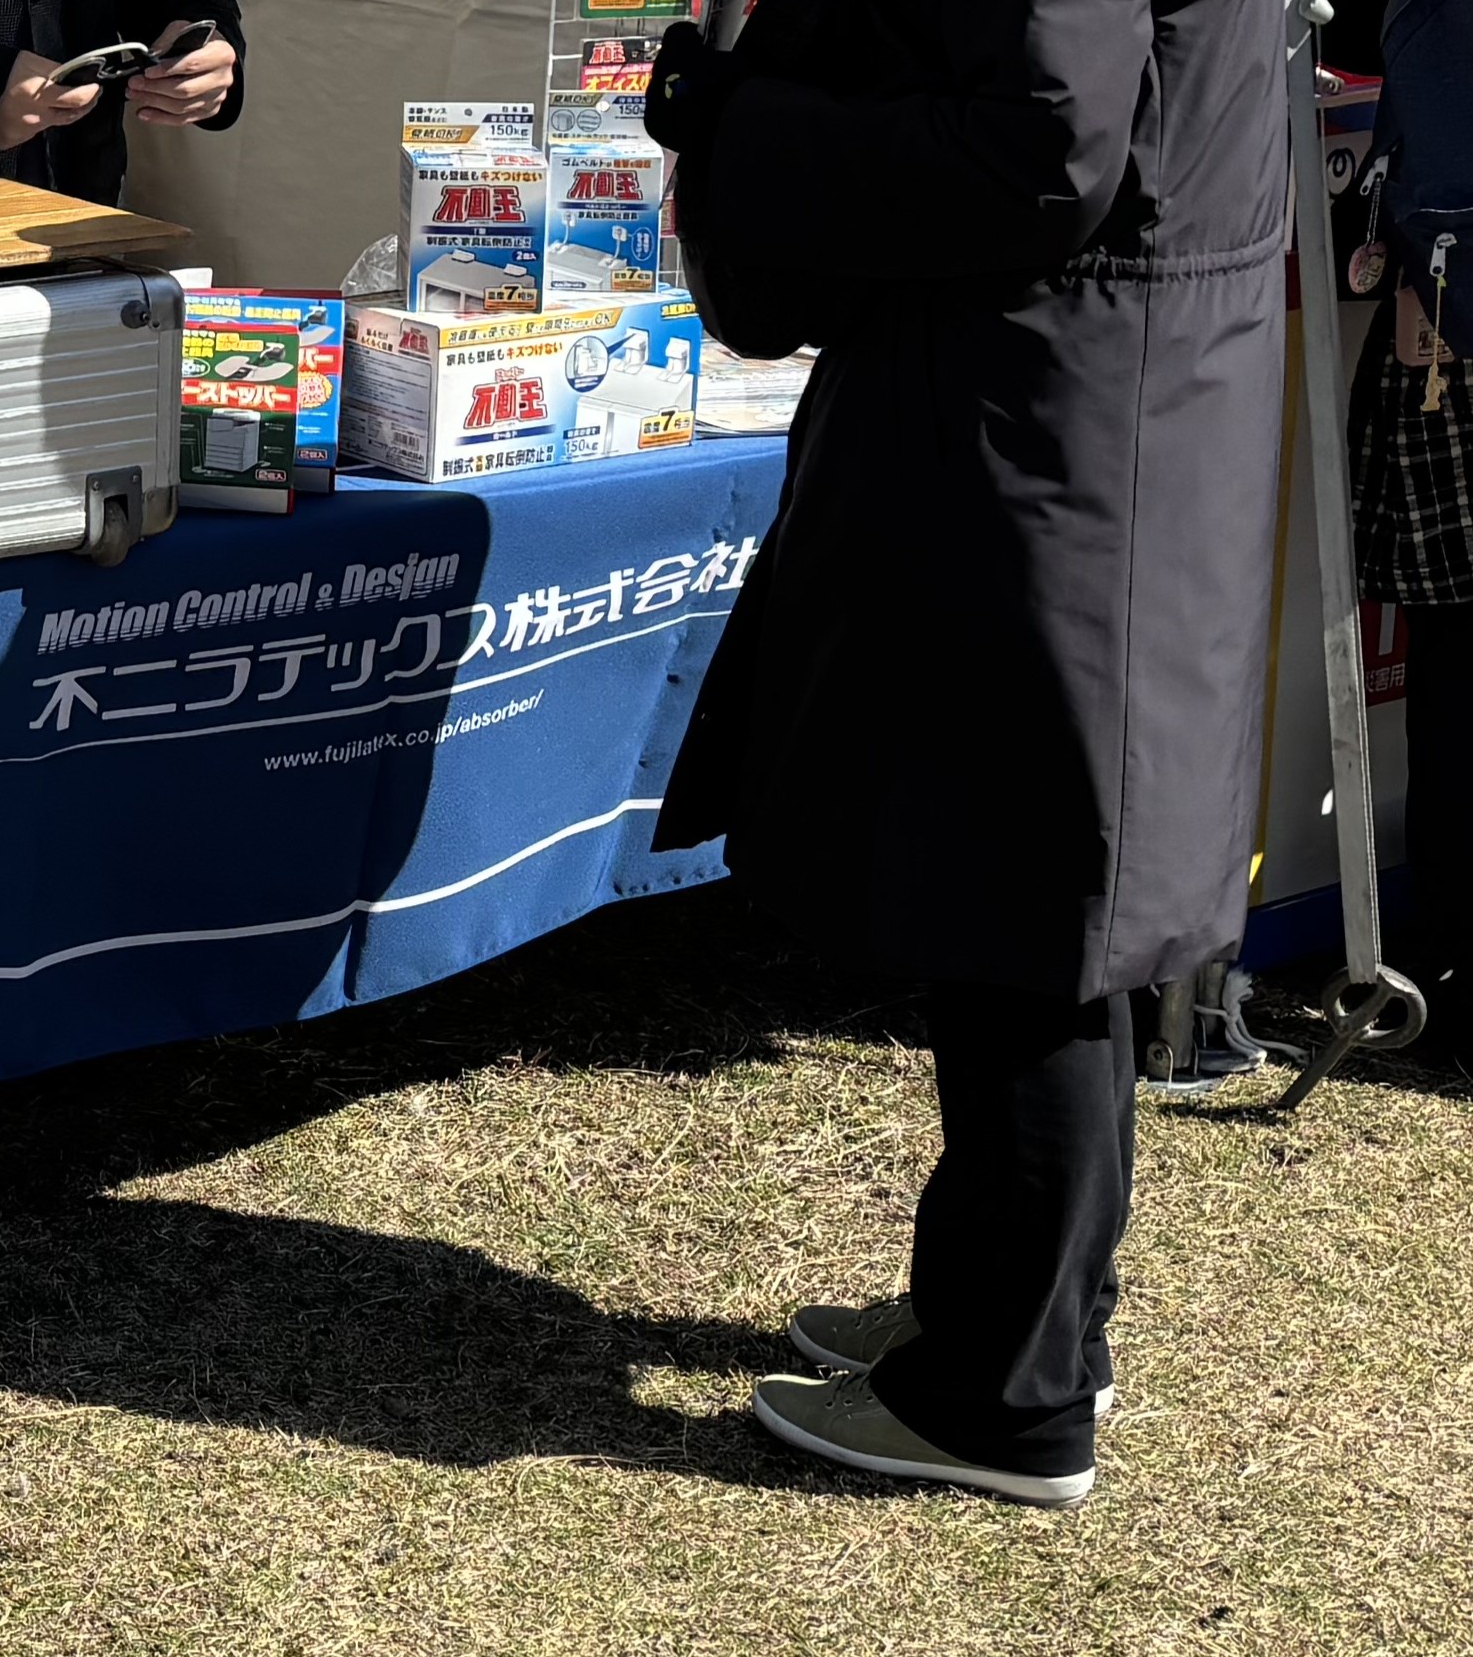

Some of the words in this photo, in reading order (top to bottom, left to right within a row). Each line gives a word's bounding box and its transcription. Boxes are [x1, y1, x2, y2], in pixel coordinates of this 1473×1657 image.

[432, 185, 527, 223] 不動王
[464, 377, 548, 430] 不動王
[29, 536, 760, 730] 不二ラテックス株式会社
[37, 600, 170, 655] Motion
[173, 573, 309, 632] Control
[315, 581, 337, 611] &
[340, 551, 460, 608] Design
